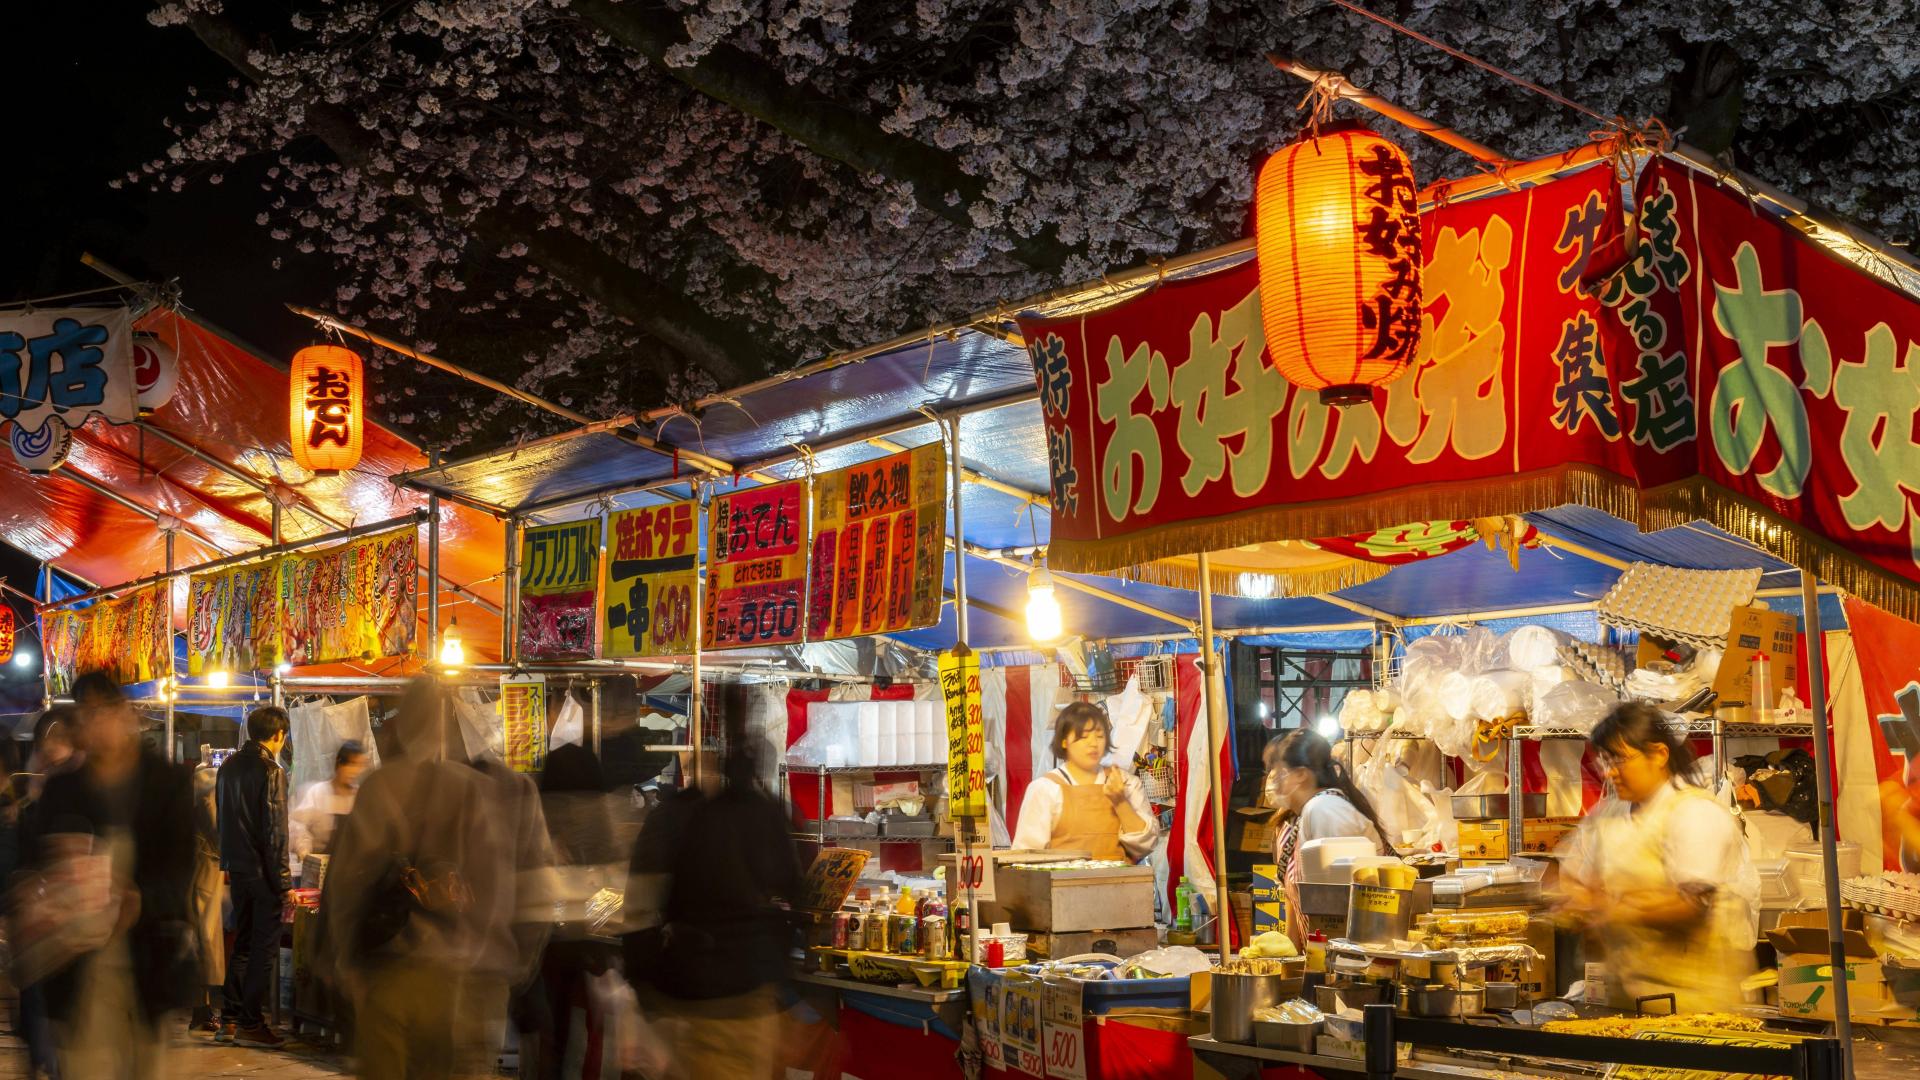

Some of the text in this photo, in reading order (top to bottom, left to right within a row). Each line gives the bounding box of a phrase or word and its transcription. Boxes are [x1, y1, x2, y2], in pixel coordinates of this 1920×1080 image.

[1357, 144, 1422, 368] お好み焼
[307, 366, 350, 448] おでん
[849, 461, 909, 518] 飲み物
[614, 503, 693, 561] 焼ホタテ
[716, 501, 730, 560] 特製
[731, 498, 794, 554] おでん
[734, 559, 783, 583] どれでも5品
[608, 577, 650, 653] 一串
[653, 584, 692, 646] 600
